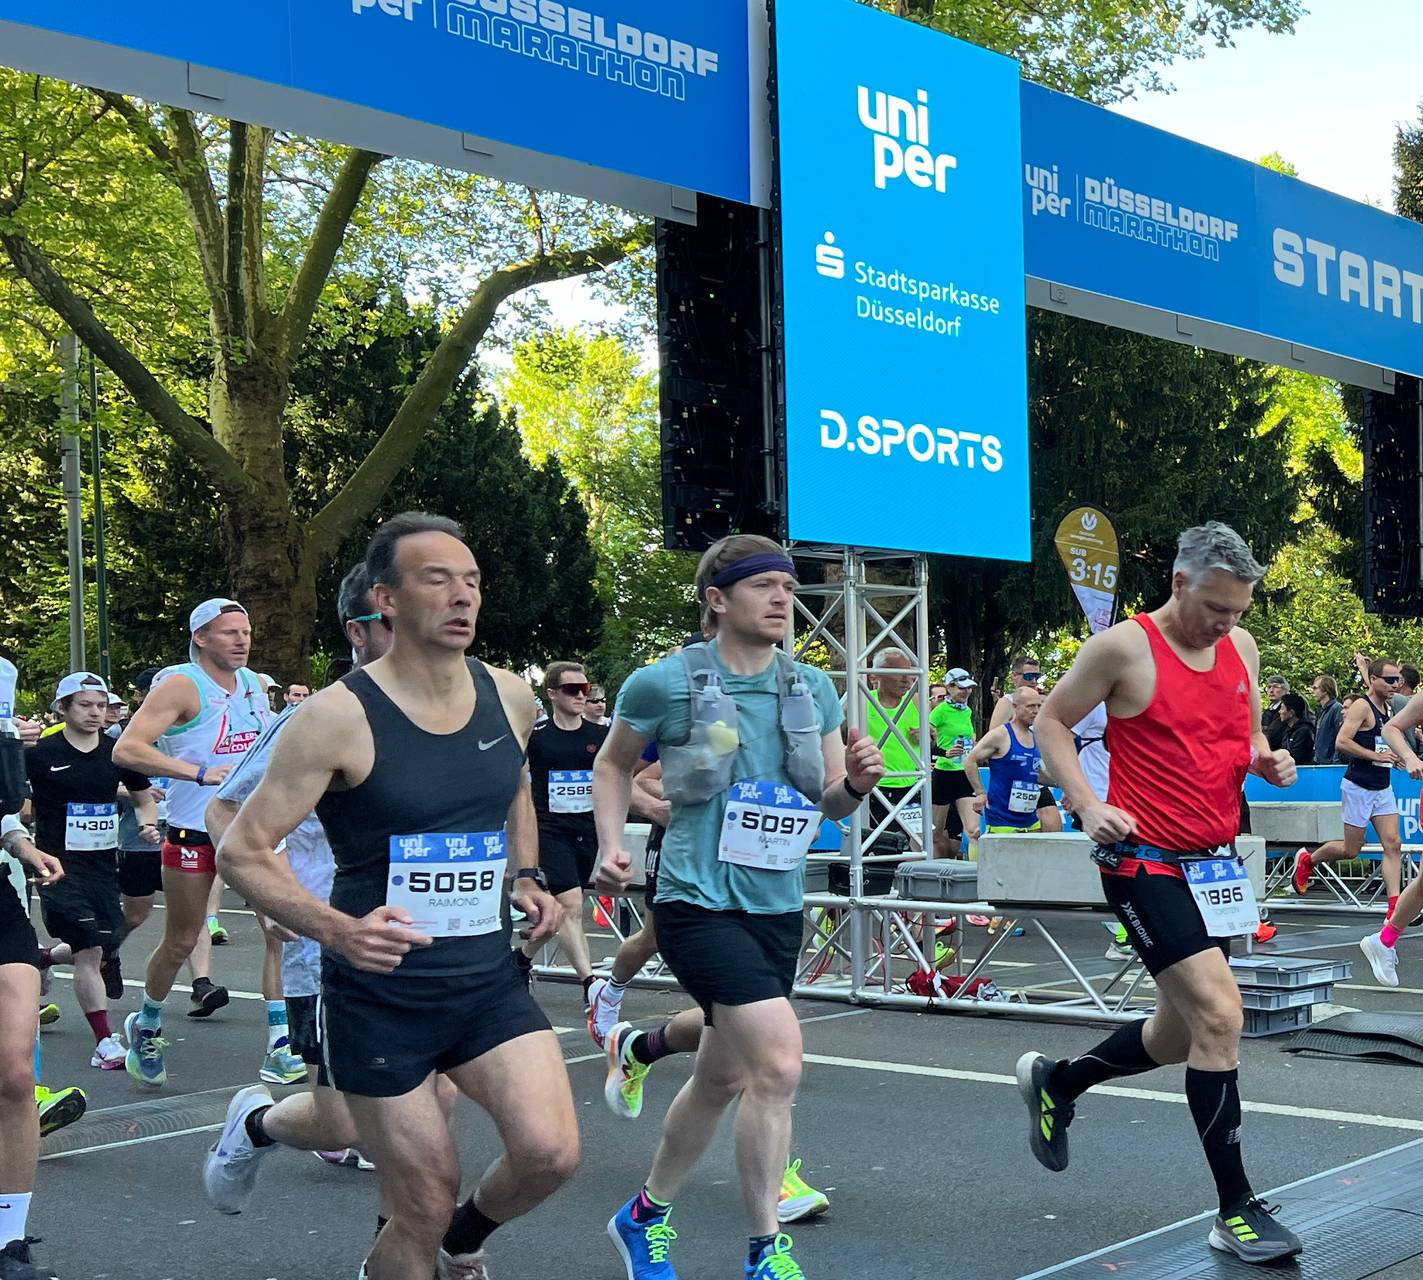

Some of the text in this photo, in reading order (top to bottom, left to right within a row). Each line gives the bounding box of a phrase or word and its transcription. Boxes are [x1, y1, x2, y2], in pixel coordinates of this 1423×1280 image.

[447, 3, 686, 101] MARATHON
[455, 0, 719, 77] SSELDORF
[857, 84, 929, 146] uni
[873, 133, 957, 194] per
[1025, 163, 1058, 194] uni
[1032, 187, 1071, 216] per
[1084, 176, 1239, 243] DÜSSELDORF
[1083, 201, 1220, 263] MARATHON
[855, 261, 1001, 315] Stadtsparkasse
[856, 295, 962, 338] Düsseldorf
[820, 408, 1004, 473] D.SPORTS
[1069, 558, 1118, 589] 3:15
[76, 820, 114, 831] 4303
[741, 811, 809, 835] 5097
[399, 832, 500, 847] uni uni uni
[404, 843, 504, 860] per per per
[408, 870, 495, 893] 5058
[1200, 886, 1244, 906] 1896
[428, 897, 480, 908] RAIMOND
[1132, 919, 1154, 948] BIONIC
